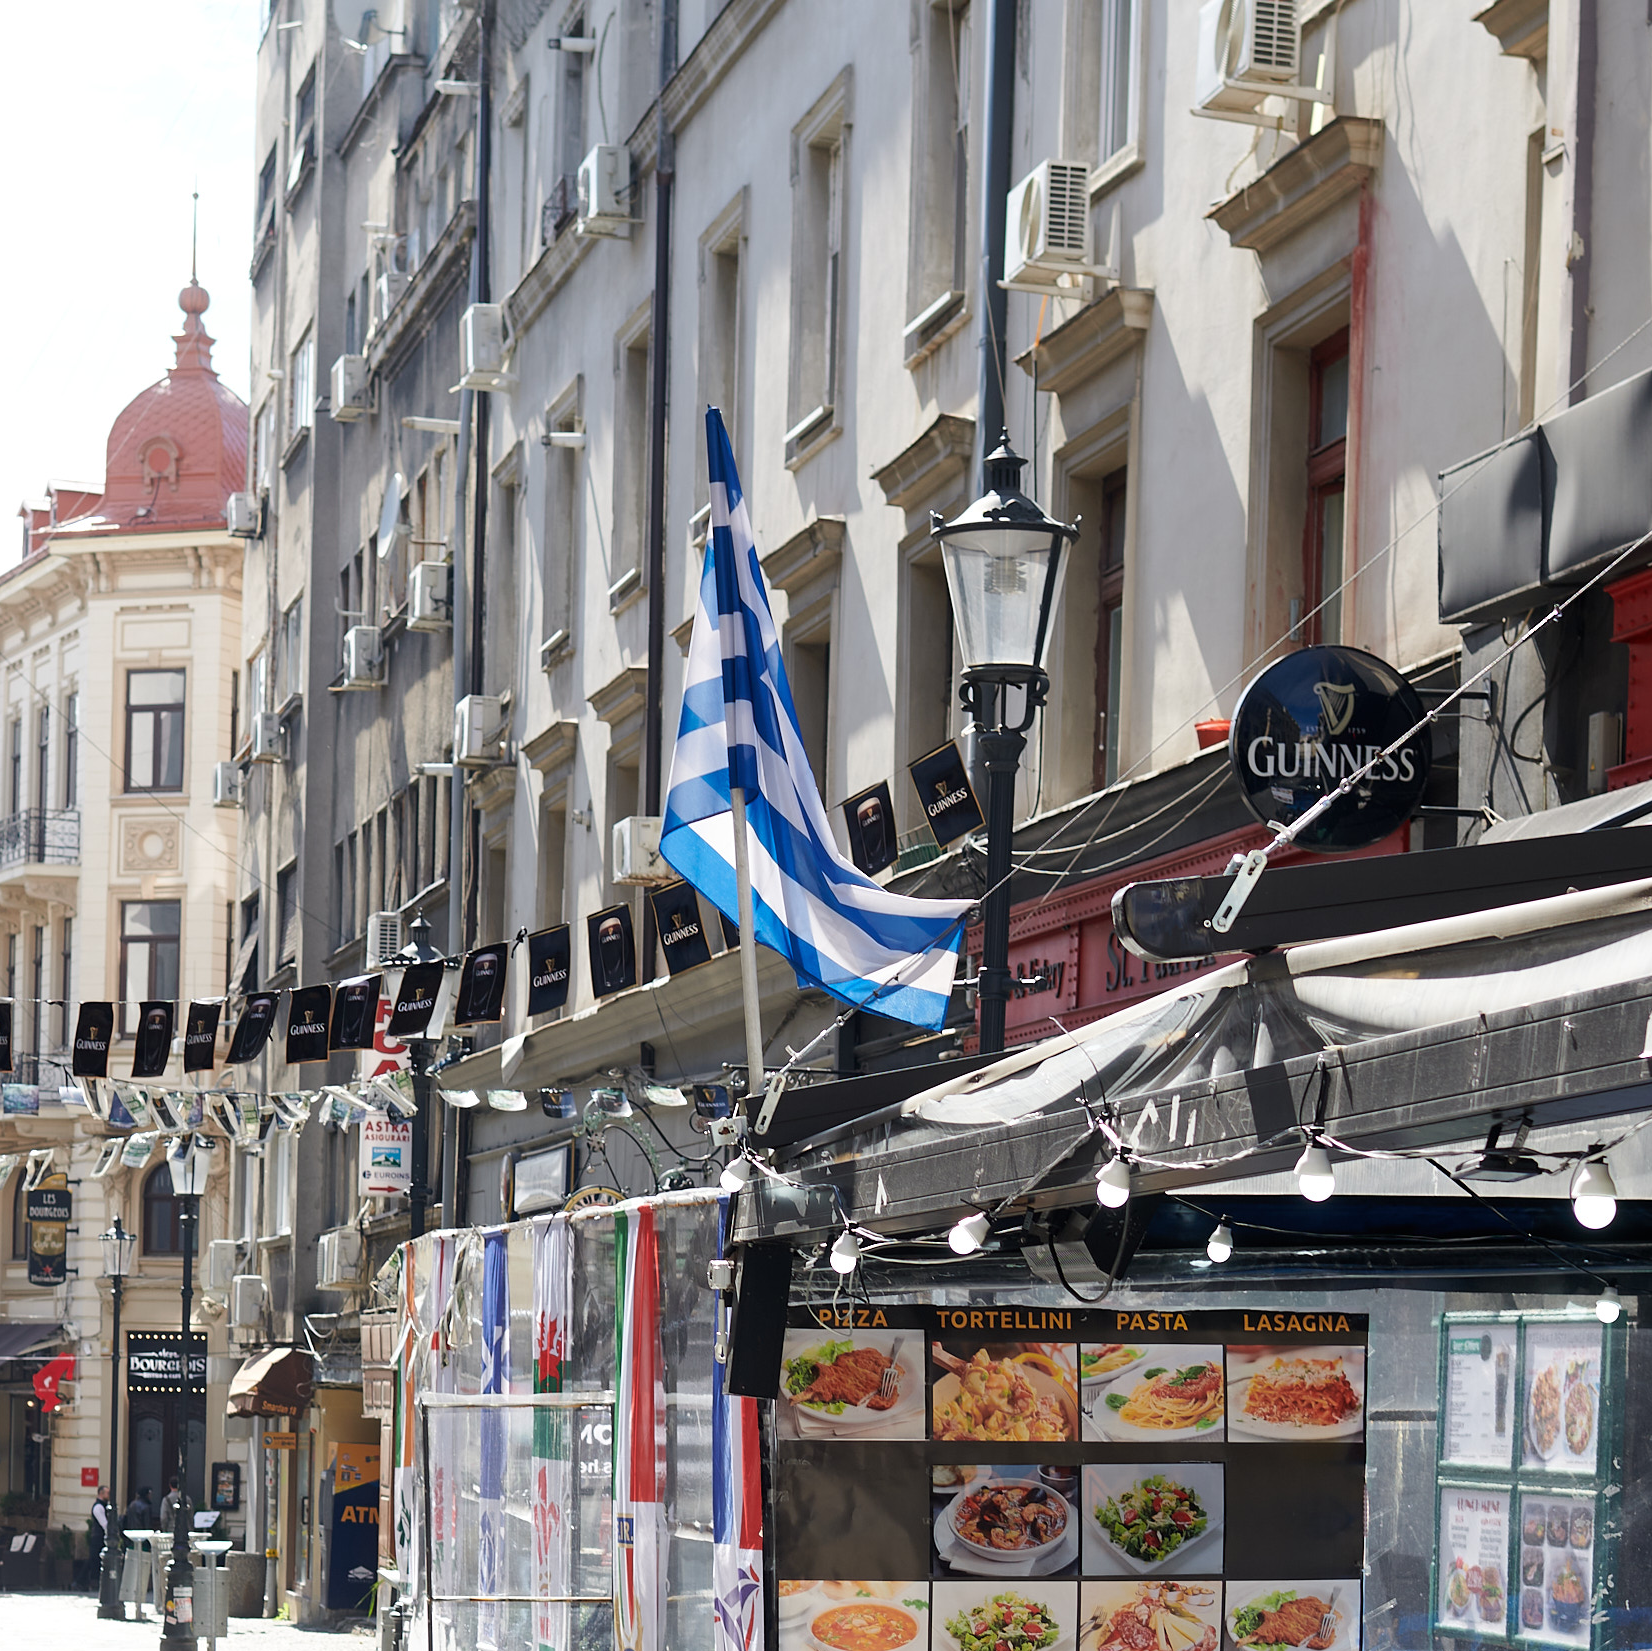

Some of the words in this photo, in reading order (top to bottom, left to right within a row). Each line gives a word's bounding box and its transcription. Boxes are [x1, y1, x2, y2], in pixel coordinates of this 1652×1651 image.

[1247, 735, 1415, 782] GUINNESS
[927, 787, 968, 818] GUINNESS
[663, 922, 699, 947] GUINNESS
[533, 968, 567, 988] GUINNESS
[398, 998, 433, 1013] GUINNESS
[290, 1022, 325, 1036] GUINNESS
[76, 1038, 107, 1051] GUINNESS
[186, 1032, 213, 1046] GUINNESS
[365, 1120, 410, 1134] ASTRA
[374, 1171, 411, 1180] EUROINS
[818, 1308, 888, 1328] PIZZA
[936, 1309, 1073, 1331] TORTELLINI
[1116, 1311, 1189, 1332] PASTA
[1243, 1313, 1350, 1334] LASAGNA
[129, 1356, 206, 1372] BOURGIS
